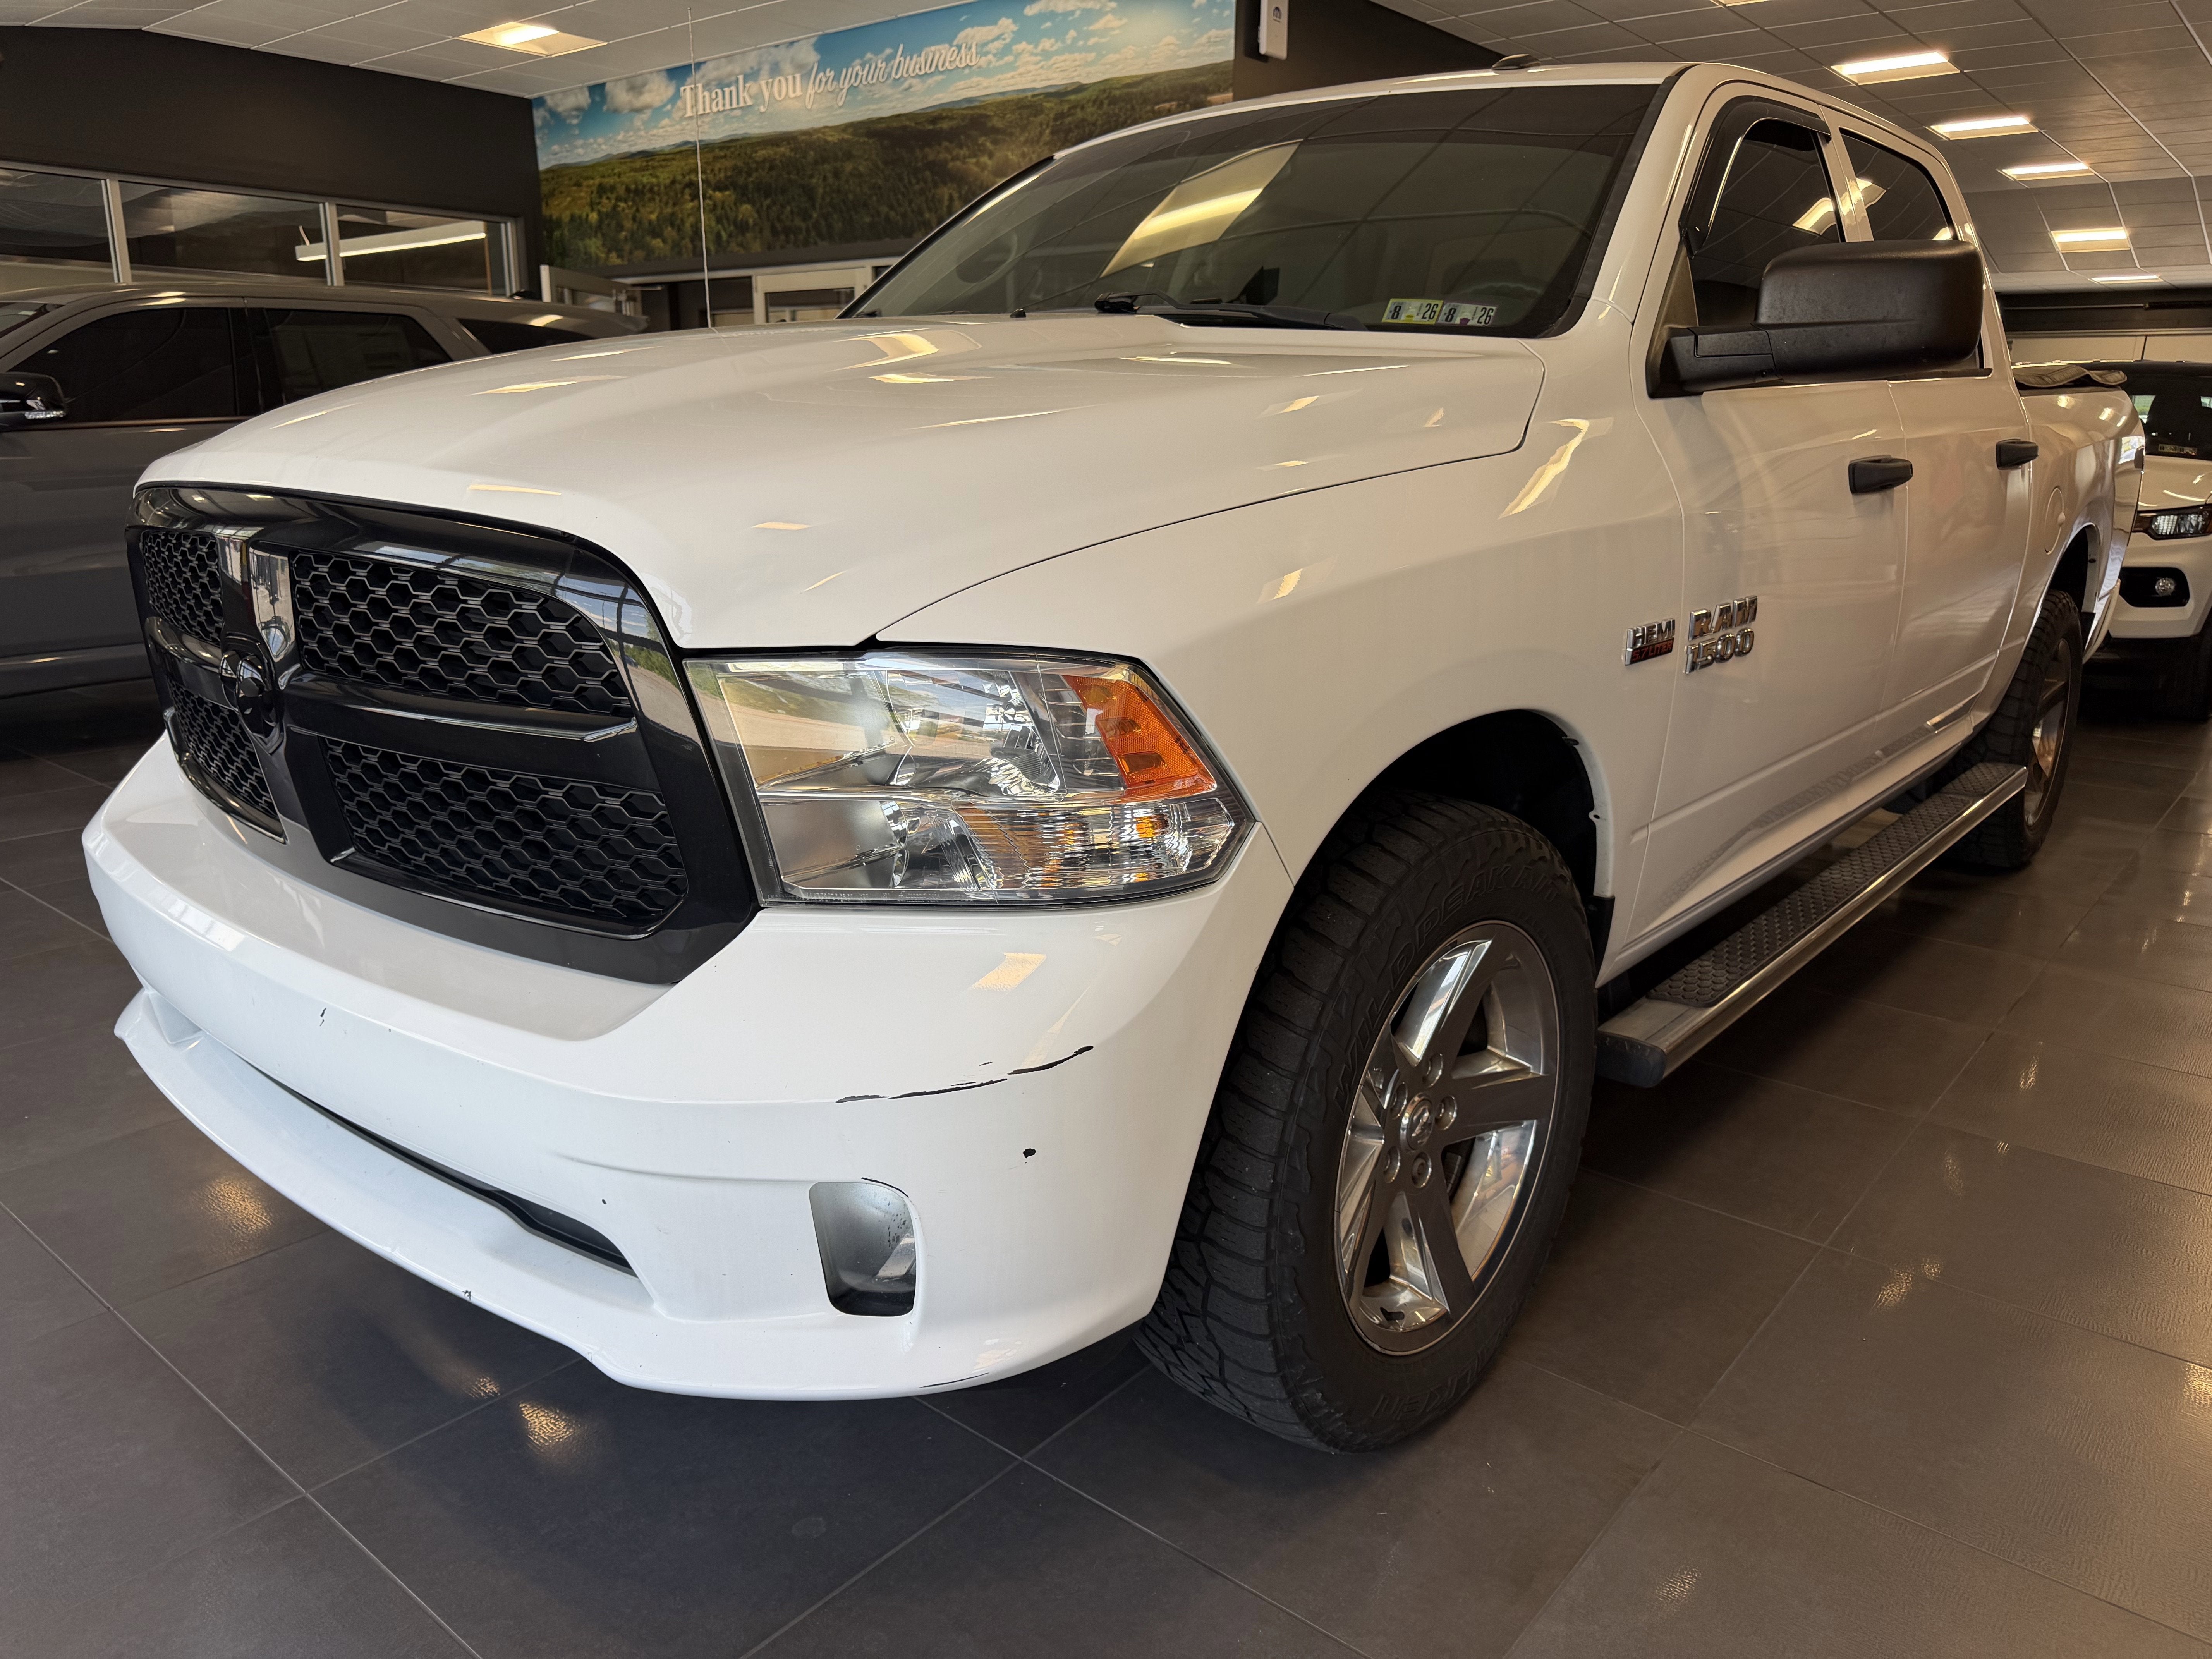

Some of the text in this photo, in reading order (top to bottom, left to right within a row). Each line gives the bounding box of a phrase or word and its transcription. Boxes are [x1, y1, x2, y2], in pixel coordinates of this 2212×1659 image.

[679, 43, 981, 117] Thank you for your business
[1391, 306, 1402, 319] 8
[1421, 303, 1439, 320] 26
[1445, 308, 1456, 322] 8
[1477, 307, 1494, 325] 26
[1626, 618, 1675, 649] HEMI
[1689, 596, 1758, 641] RAM
[1685, 627, 1755, 674] 1500
